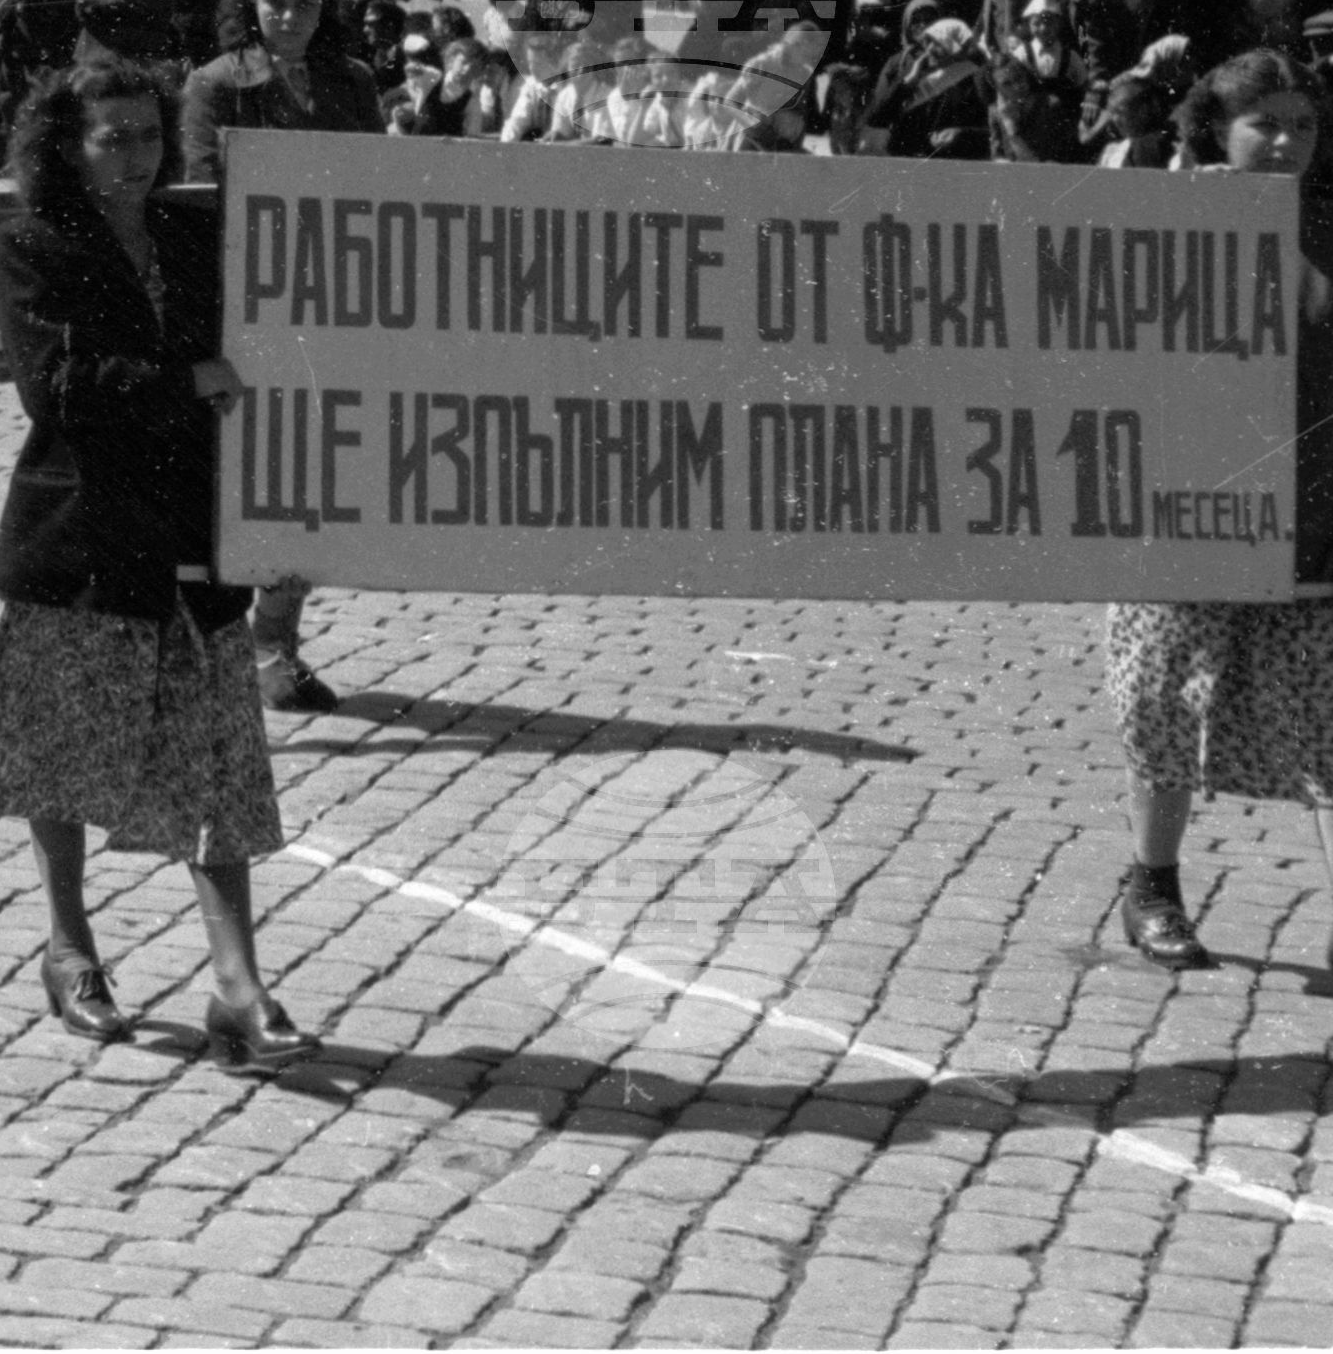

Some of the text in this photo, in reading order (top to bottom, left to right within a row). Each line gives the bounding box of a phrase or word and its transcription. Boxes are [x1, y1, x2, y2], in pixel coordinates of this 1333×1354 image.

[244, 193, 1288, 361] РАБОТНИЦИТЕ ОТ Ф-КА МАРИЦА
[241, 385, 1297, 546] ЩЕ ИЗПЪЛНИМ ПЛАНА ЗА 10 МЕСЕЦА.
